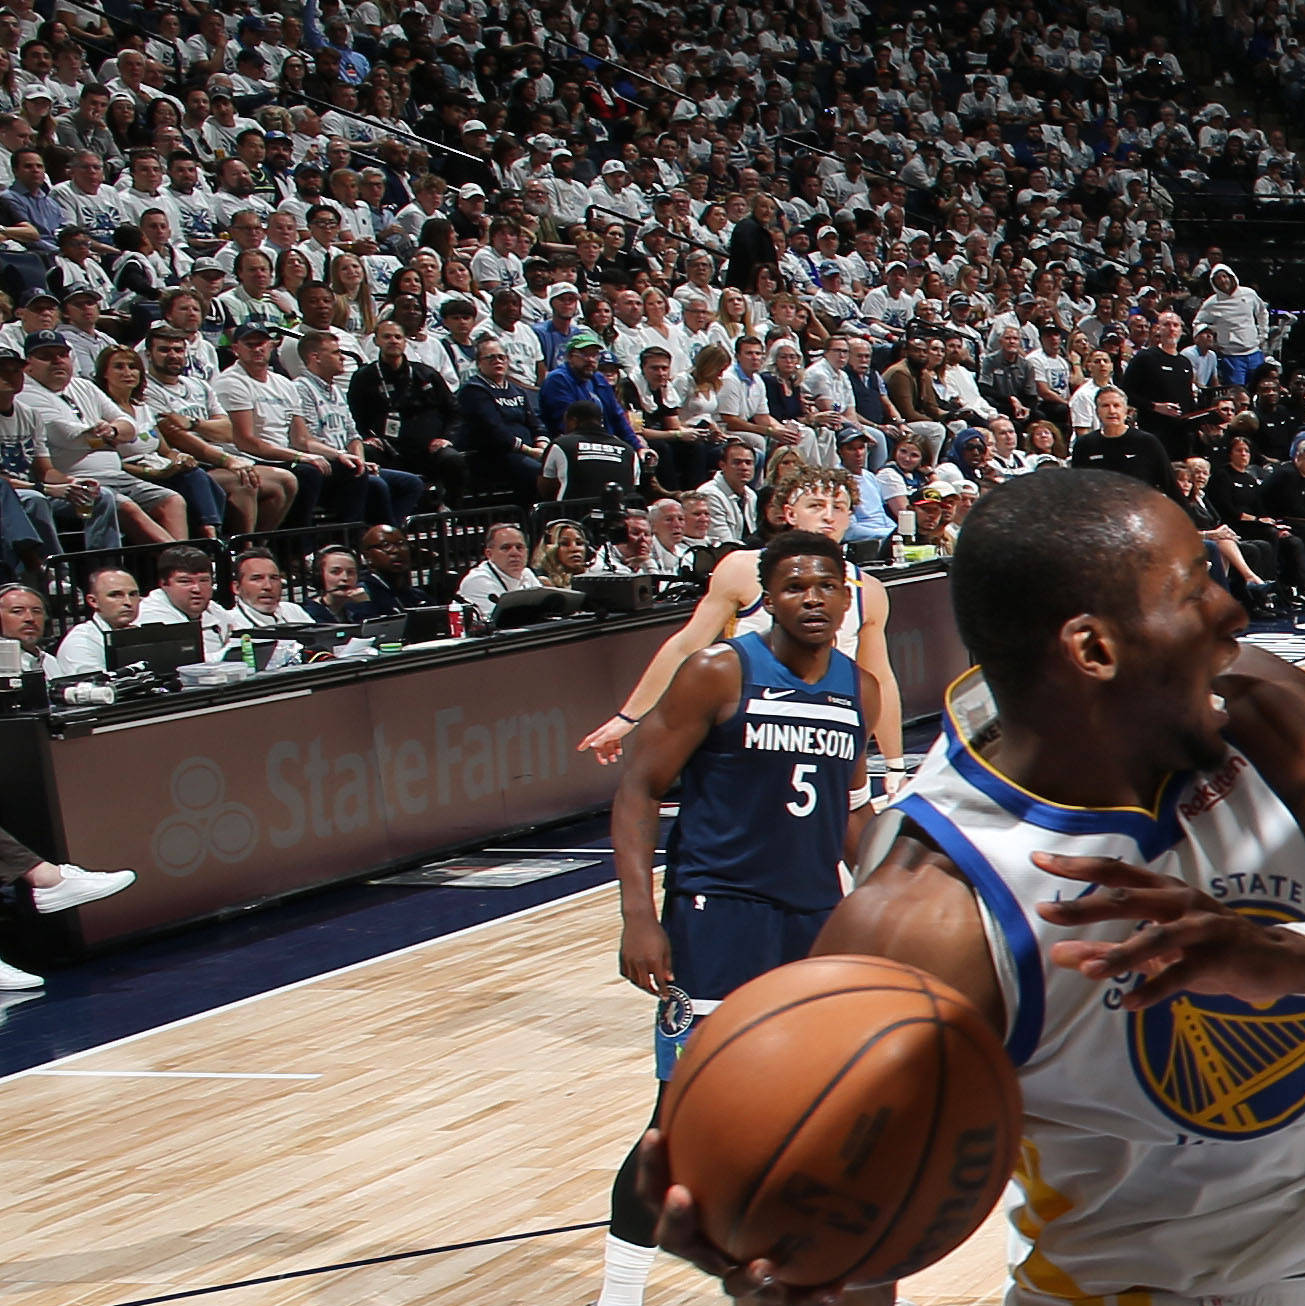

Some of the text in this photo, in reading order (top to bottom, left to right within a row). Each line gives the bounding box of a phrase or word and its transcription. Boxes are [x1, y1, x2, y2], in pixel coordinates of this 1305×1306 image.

[744, 722, 856, 761] MINNESOTA
[786, 763, 818, 817] 5
[1177, 754, 1249, 822] Rakuten
[1210, 872, 1304, 902] STATE
